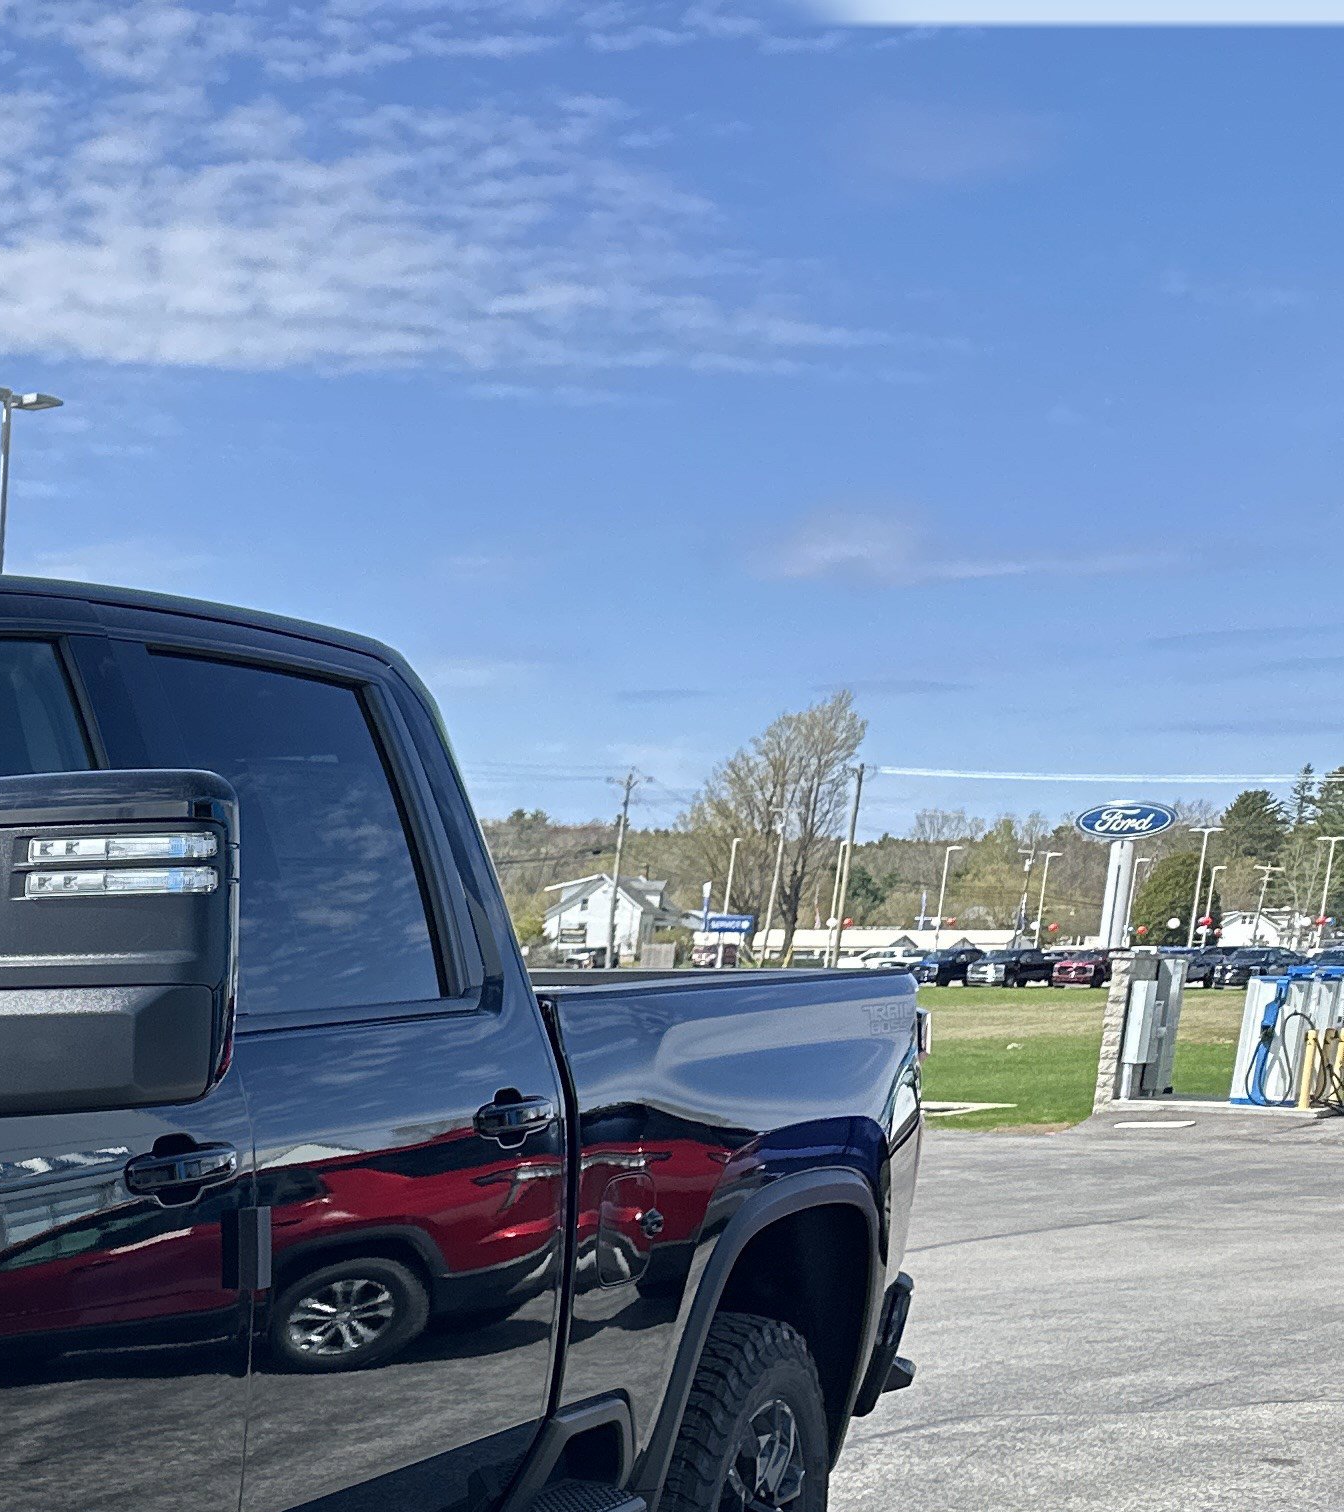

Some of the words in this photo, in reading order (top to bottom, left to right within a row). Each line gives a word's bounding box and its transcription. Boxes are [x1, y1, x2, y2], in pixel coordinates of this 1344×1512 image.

[1094, 808, 1156, 832] Ford
[861, 1002, 914, 1021] TRAIL
[870, 1019, 910, 1036] BOSS
